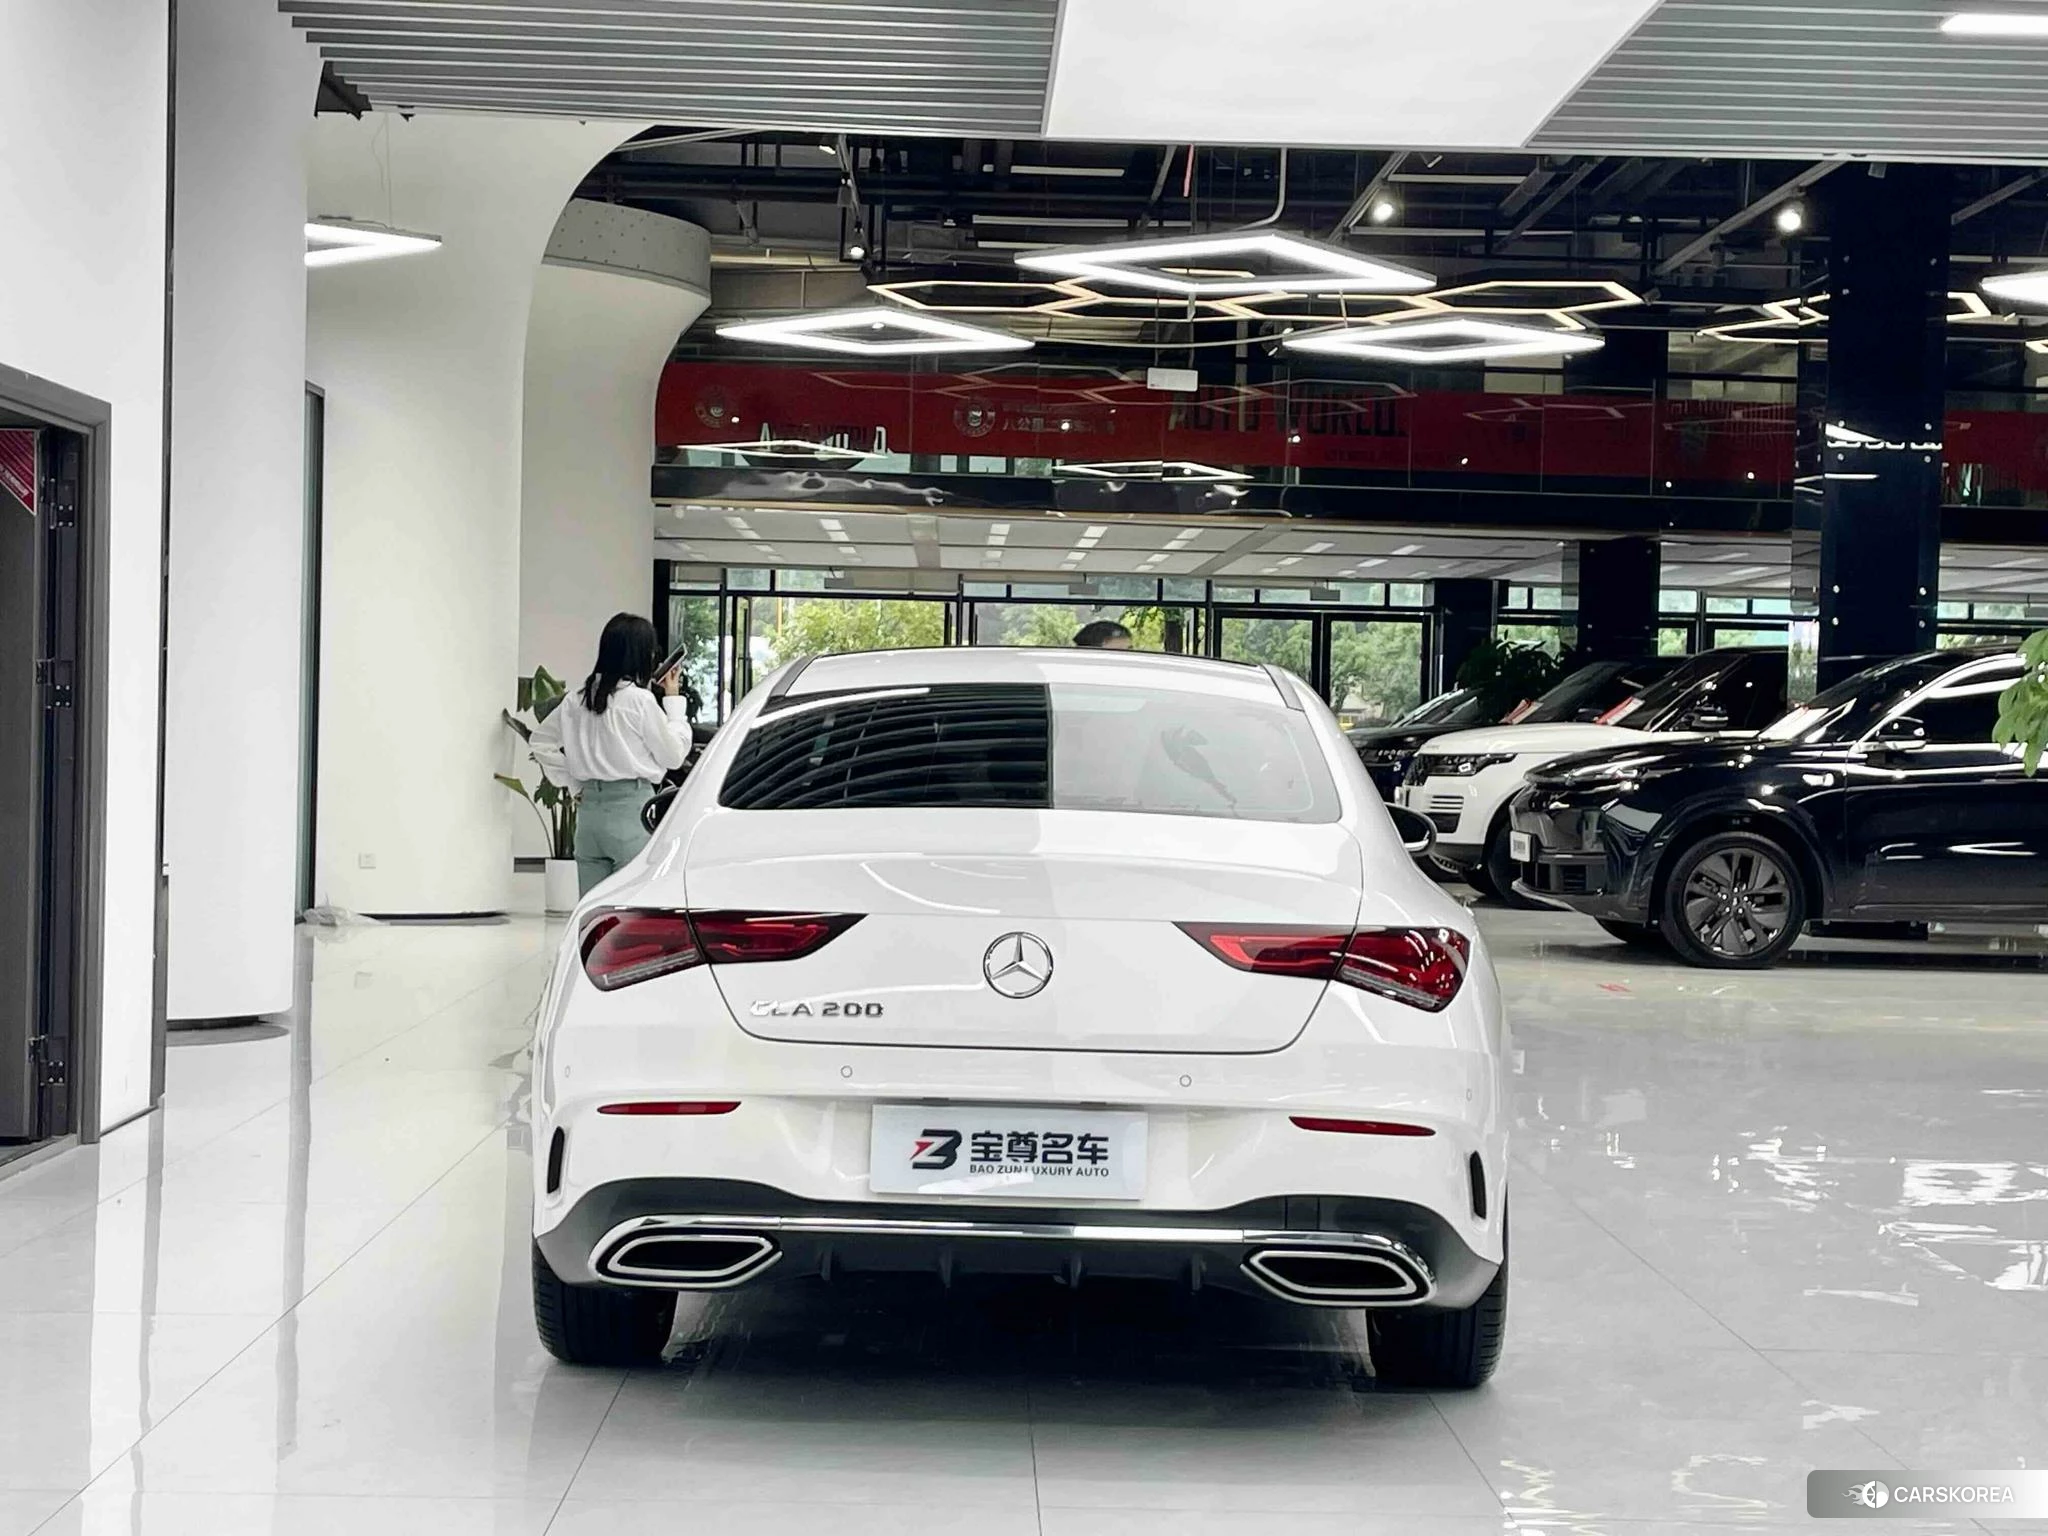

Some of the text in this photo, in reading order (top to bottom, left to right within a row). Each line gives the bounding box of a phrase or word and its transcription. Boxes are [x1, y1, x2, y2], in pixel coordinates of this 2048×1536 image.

[822, 1001, 884, 1017] 200
[970, 1130, 1109, 1165] 宝尊名车
[969, 1164, 994, 1174] BAO
[997, 1165, 1022, 1175] ZUN
[1076, 1167, 1109, 1177] AUTO
